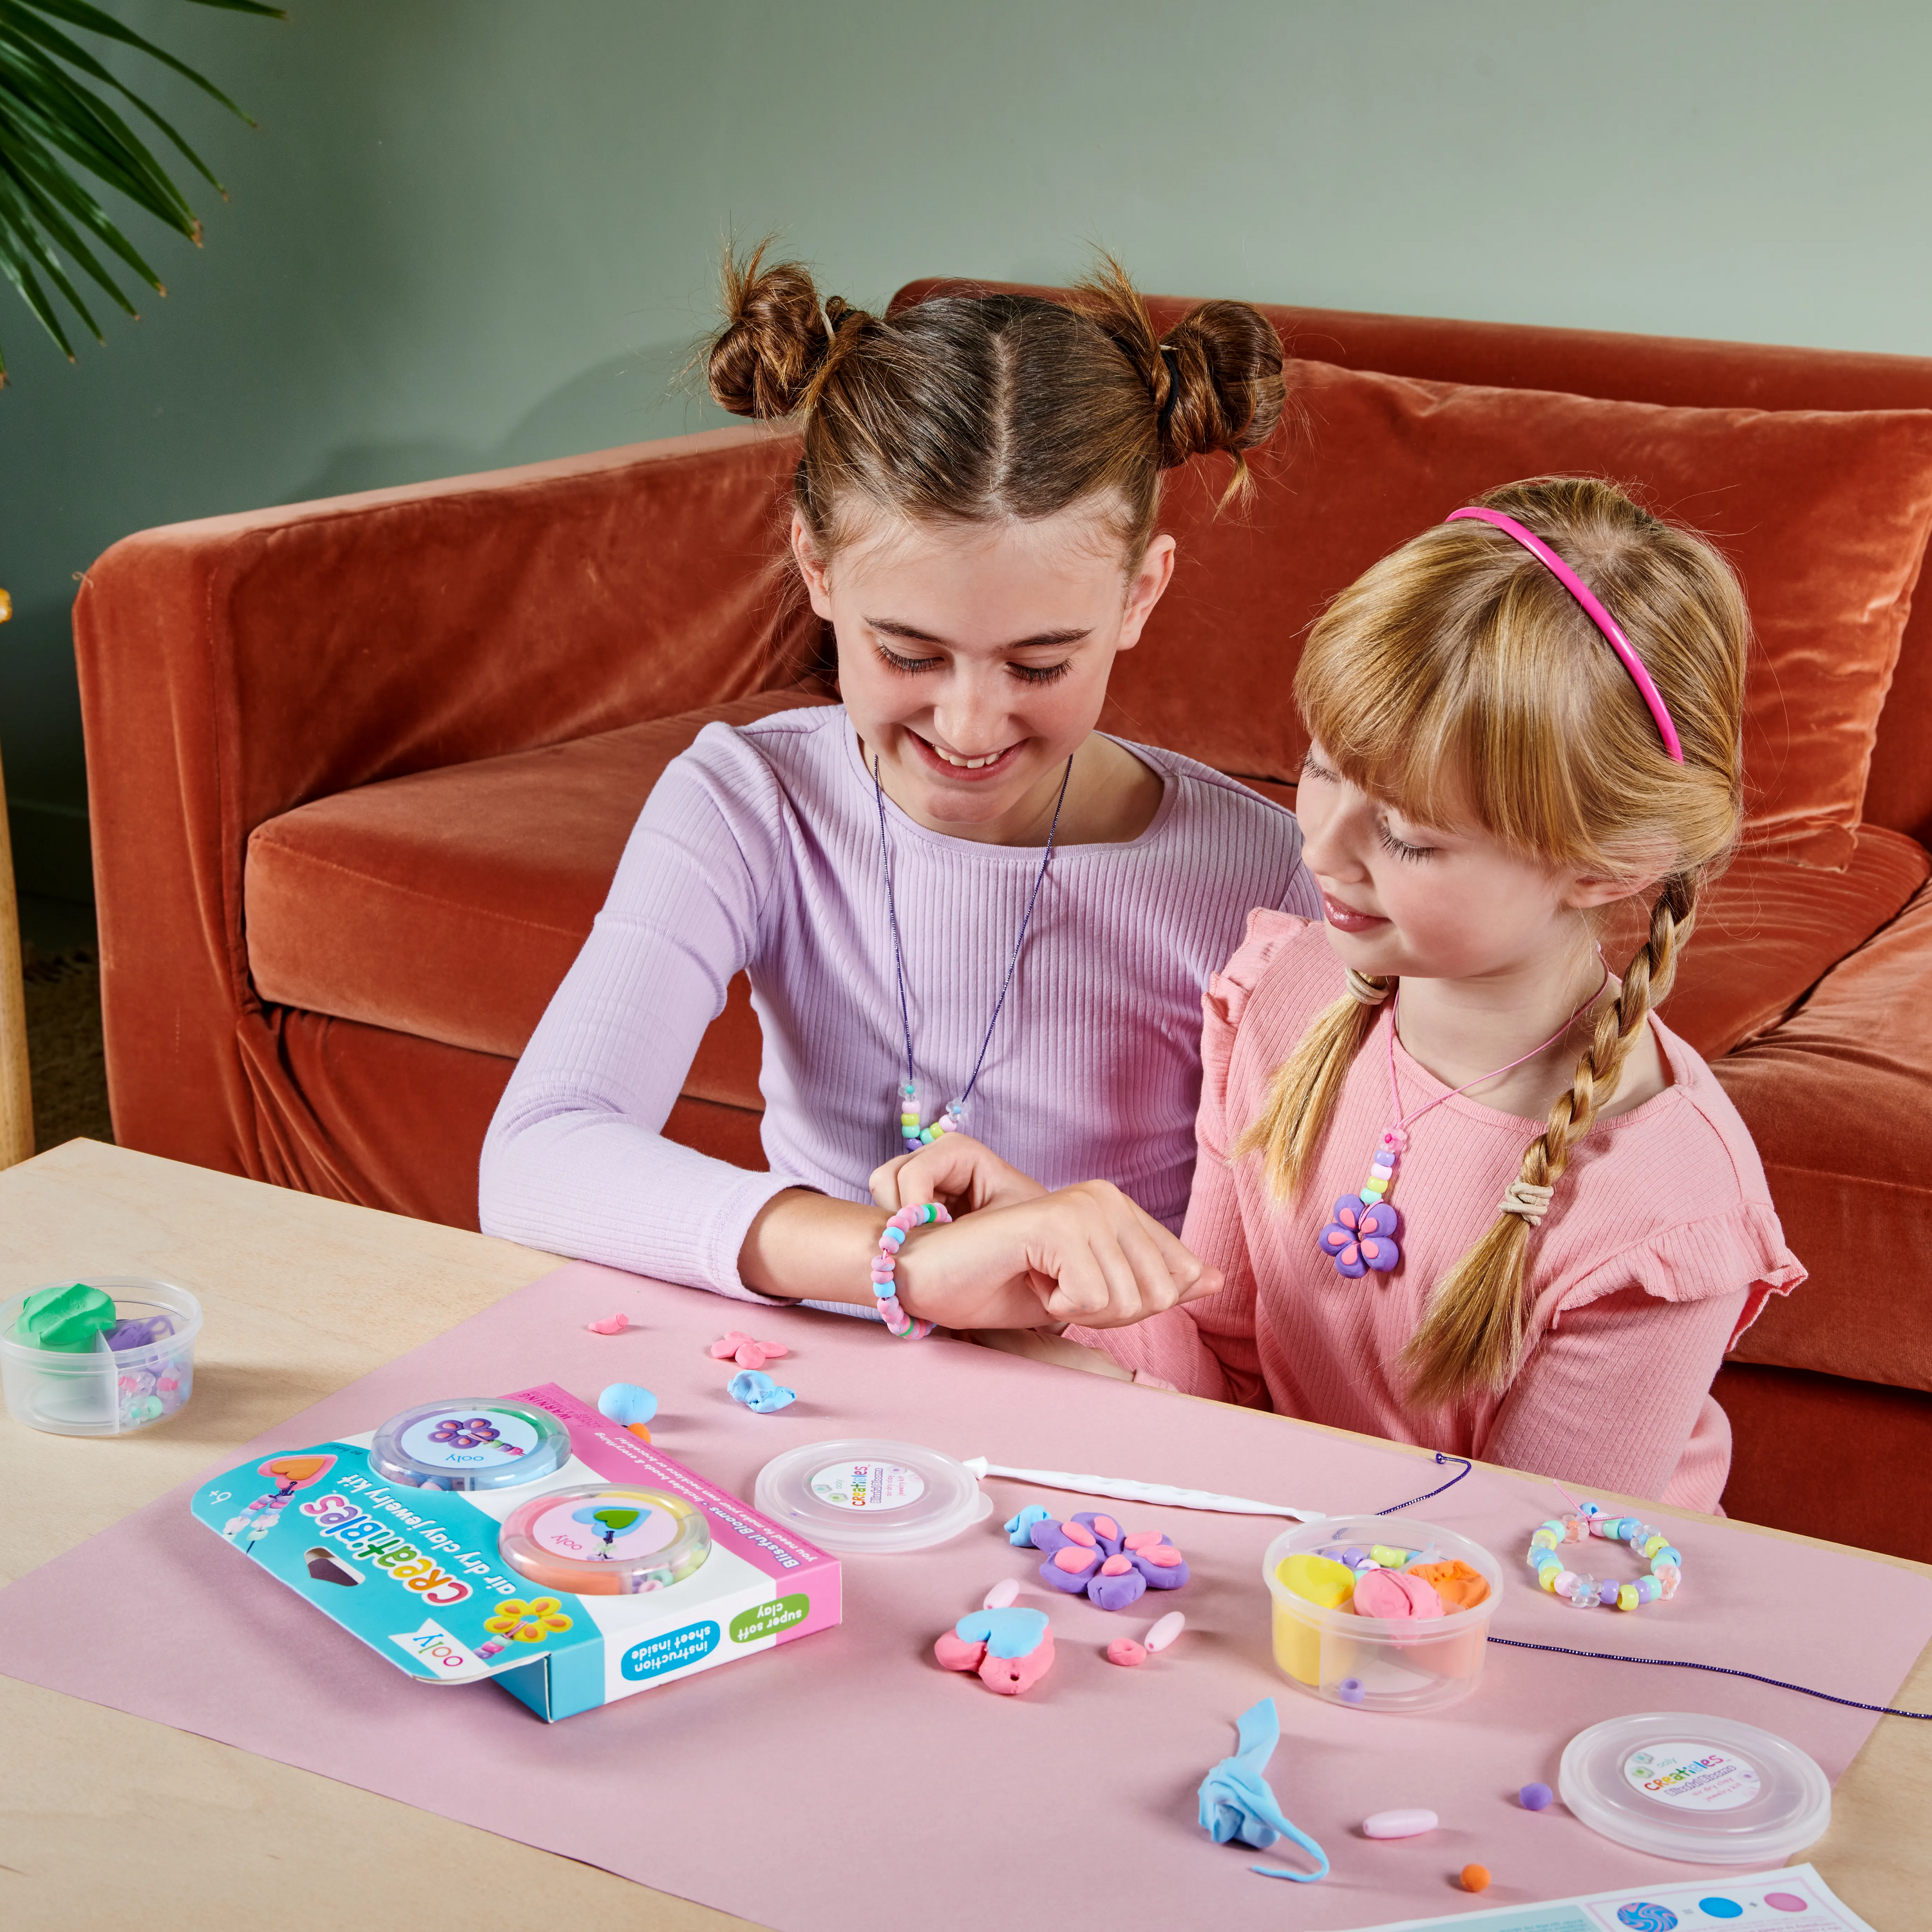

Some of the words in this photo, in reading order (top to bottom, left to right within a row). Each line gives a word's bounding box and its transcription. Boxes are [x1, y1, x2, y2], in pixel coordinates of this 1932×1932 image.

[518, 1393, 572, 1420] WARNING
[594, 1432, 637, 1459] everything
[614, 1437, 658, 1461] bracelets!
[444, 1454, 484, 1463] ooly
[644, 1464, 670, 1480] beads
[666, 1468, 704, 1490] necklace
[871, 1468, 883, 1485] Blooms
[337, 1473, 373, 1493] kit
[668, 1479, 705, 1502] Includes
[209, 1490, 232, 1505] 6+
[702, 1490, 721, 1502] own
[869, 1485, 882, 1504] Blissful
[365, 1486, 437, 1531] jewelry
[719, 1502, 744, 1513] your
[708, 1506, 756, 1535] Blooms
[739, 1513, 765, 1528] make
[419, 1527, 460, 1552] clay
[551, 1534, 582, 1550] ooly
[771, 1534, 798, 1549] need
[746, 1533, 802, 1569] Blissful
[795, 1549, 818, 1562] you
[454, 1551, 490, 1574] dry
[484, 1575, 516, 1595] air
[757, 1602, 784, 1619] clay
[766, 1609, 802, 1630] super
[674, 1626, 711, 1648] sheet
[738, 1622, 763, 1642] soft
[413, 1633, 463, 1667] ooly
[631, 1640, 671, 1661] inside
[634, 1640, 708, 1672] instruction
[1663, 1778, 1703, 1797] Blissful
[1697, 1765, 1737, 1783] Blooms
